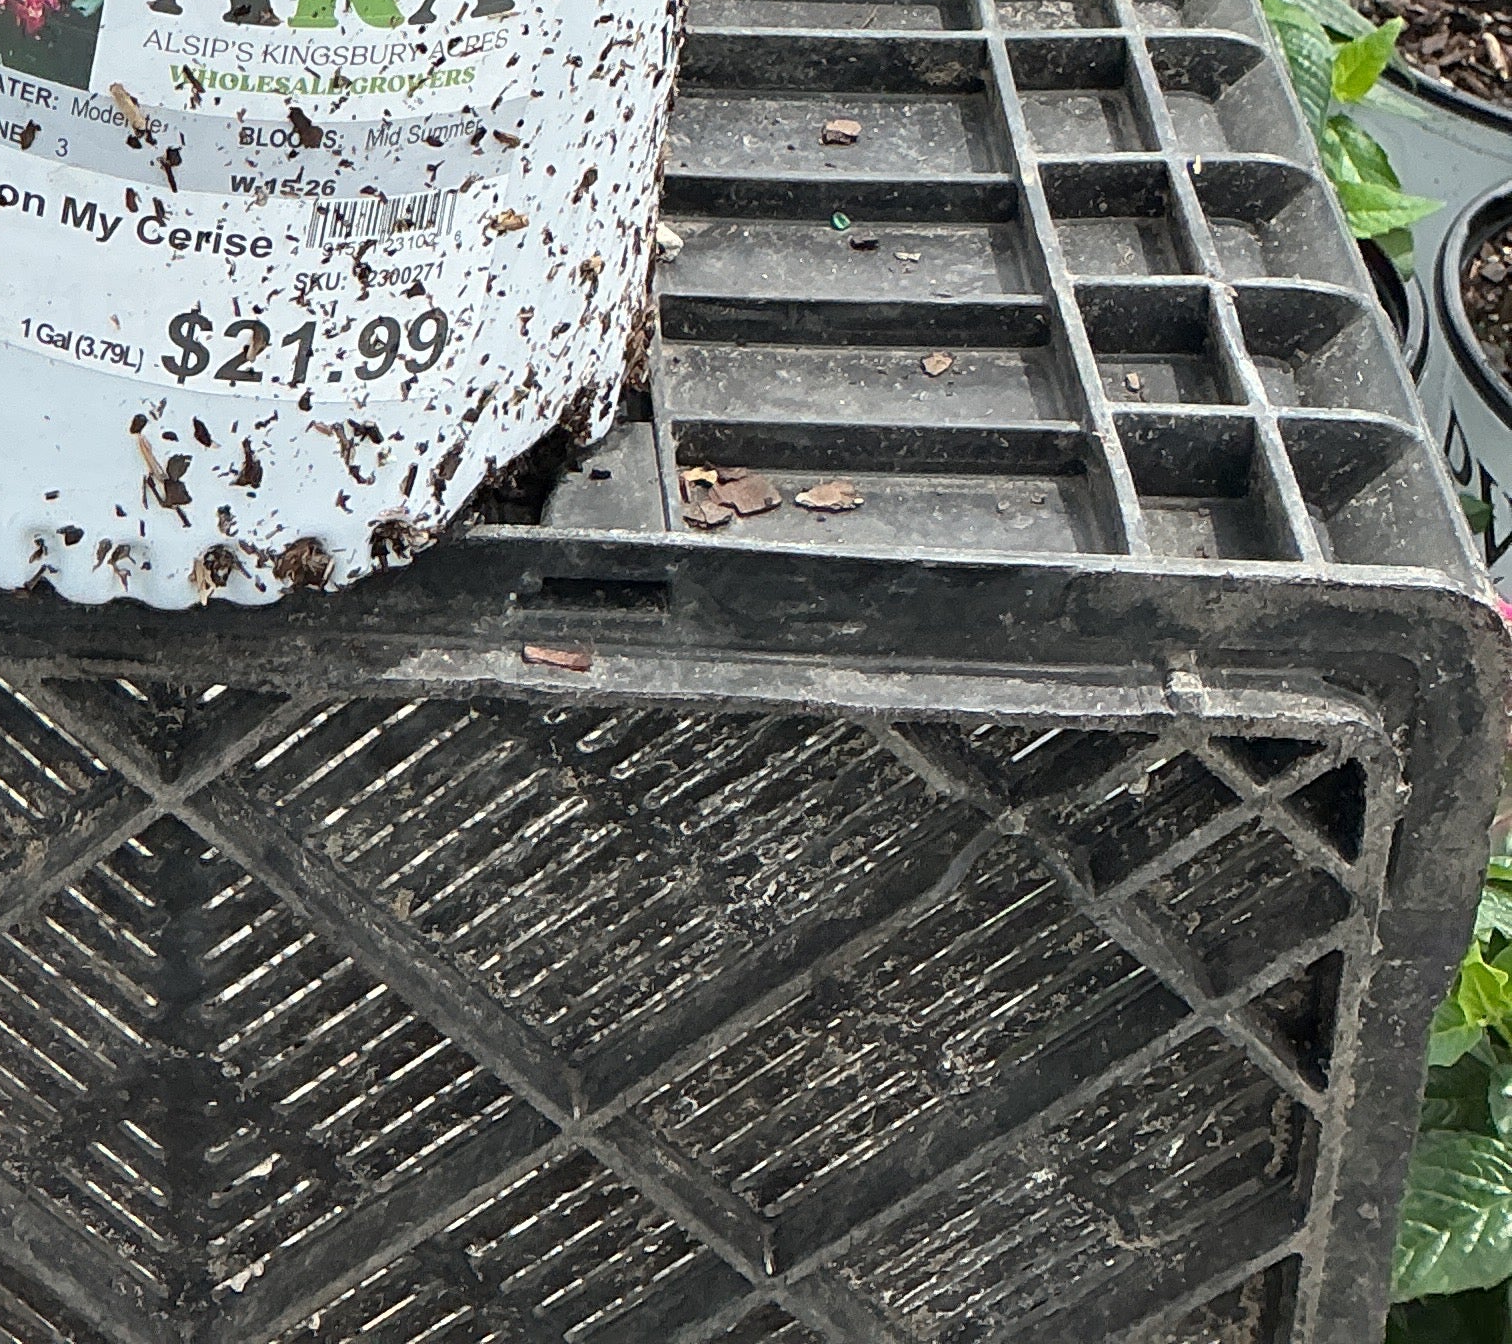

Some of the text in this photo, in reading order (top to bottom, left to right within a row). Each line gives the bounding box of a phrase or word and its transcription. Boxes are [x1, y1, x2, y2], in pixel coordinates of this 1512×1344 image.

[143, 28, 509, 67] ALSIP'S KINGSBURY ACRES
[170, 64, 476, 96] WHOLESALE GROWERS
[55, 138, 68, 157] 3
[239, 118, 484, 150] BLOOS: Mid Summer
[61, 196, 123, 242] My
[136, 215, 273, 259] Cerise
[294, 272, 347, 296] SKU:
[37, 323, 73, 351] Gal
[75, 335, 145, 374] (3.79L)
[161, 306, 449, 386] $21.99
